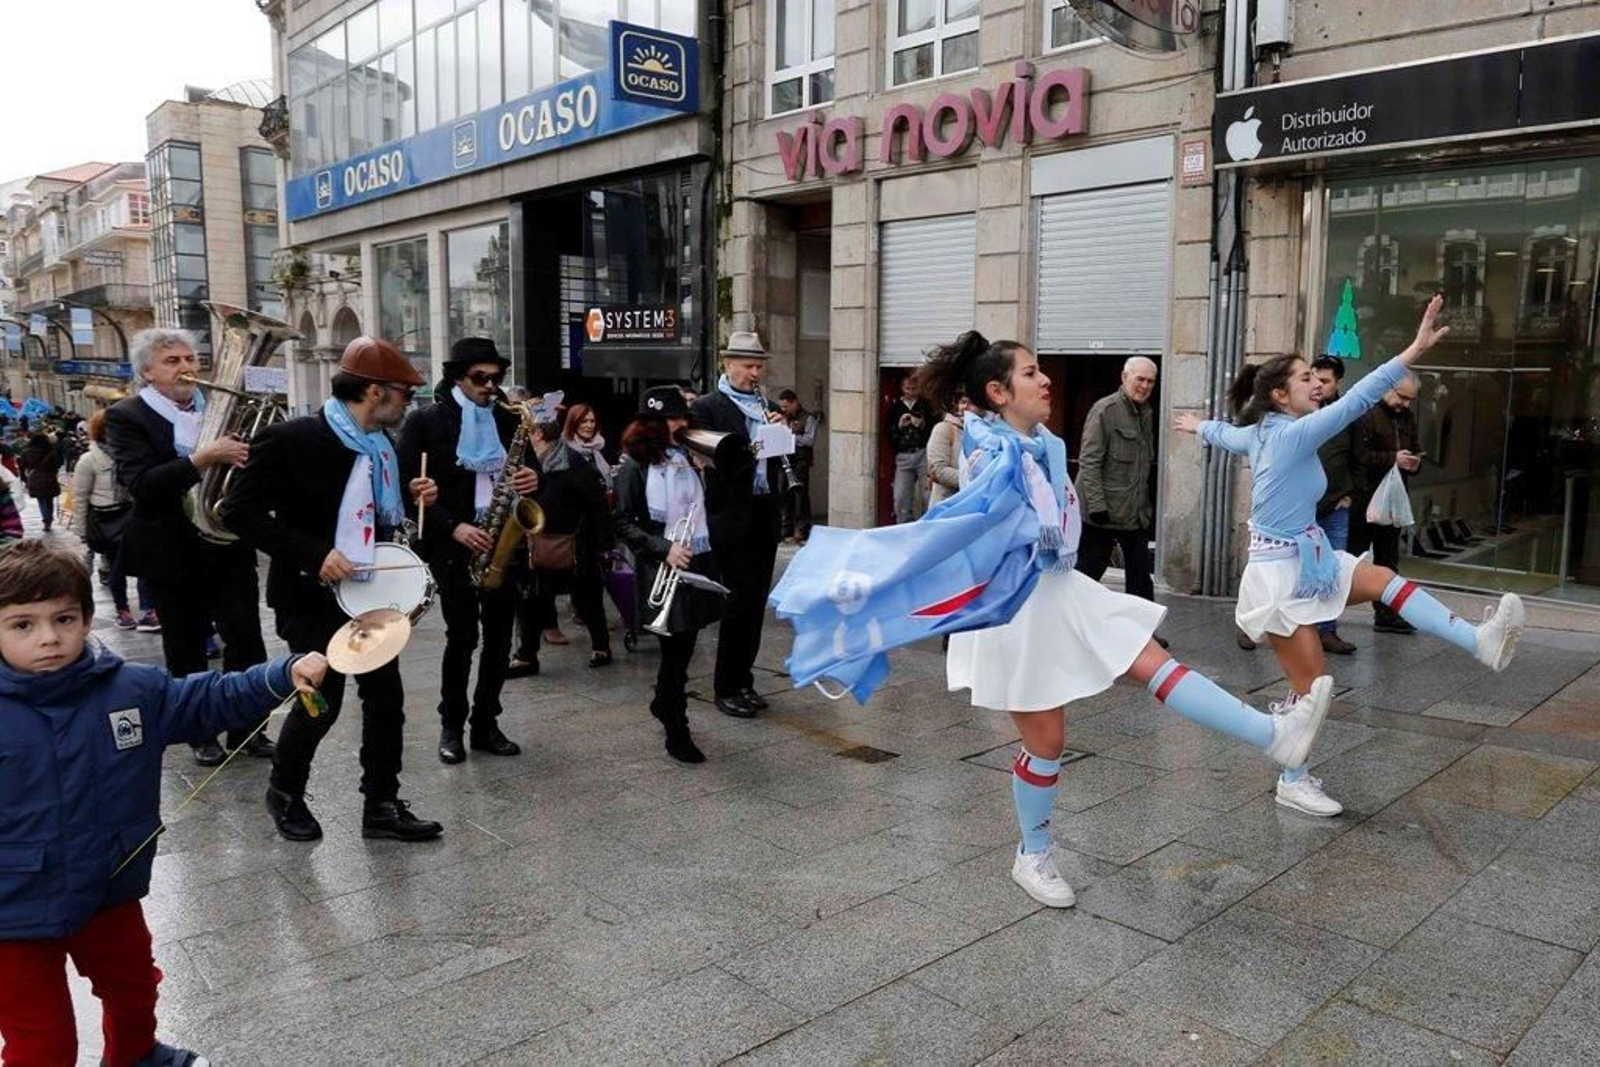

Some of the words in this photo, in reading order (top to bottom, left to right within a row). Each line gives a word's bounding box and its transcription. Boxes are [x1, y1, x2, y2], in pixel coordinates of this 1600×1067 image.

[627, 73, 679, 93] OCASO
[499, 84, 598, 151] OCASO
[776, 108, 865, 182] via
[880, 60, 1092, 163] novia
[1281, 102, 1374, 131] Distribuidor
[1281, 127, 1367, 154] Autorizado
[344, 150, 404, 197] OCASO
